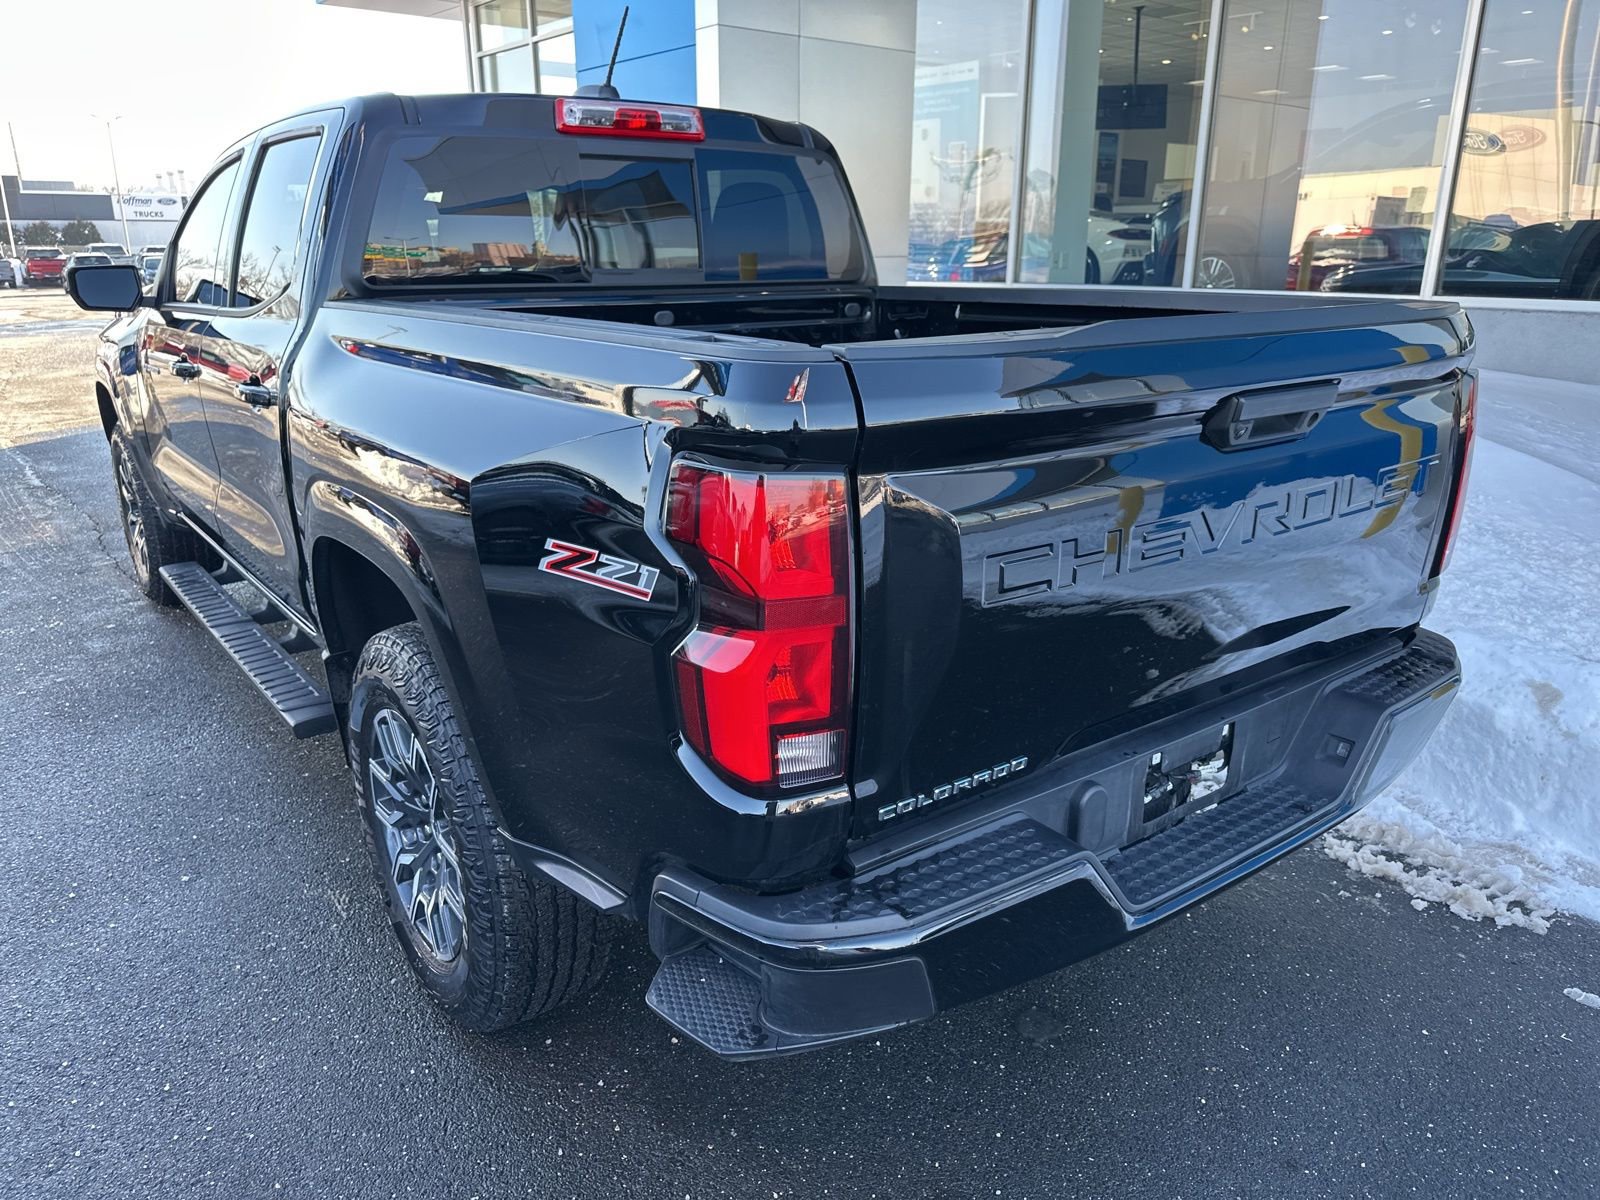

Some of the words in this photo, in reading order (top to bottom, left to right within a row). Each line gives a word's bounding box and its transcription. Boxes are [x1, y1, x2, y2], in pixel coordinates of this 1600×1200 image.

[134, 210, 164, 218] TRUCKS
[981, 456, 1440, 608] CHEVROLET
[538, 538, 660, 602] Z71
[878, 756, 1028, 822] COLORADO
